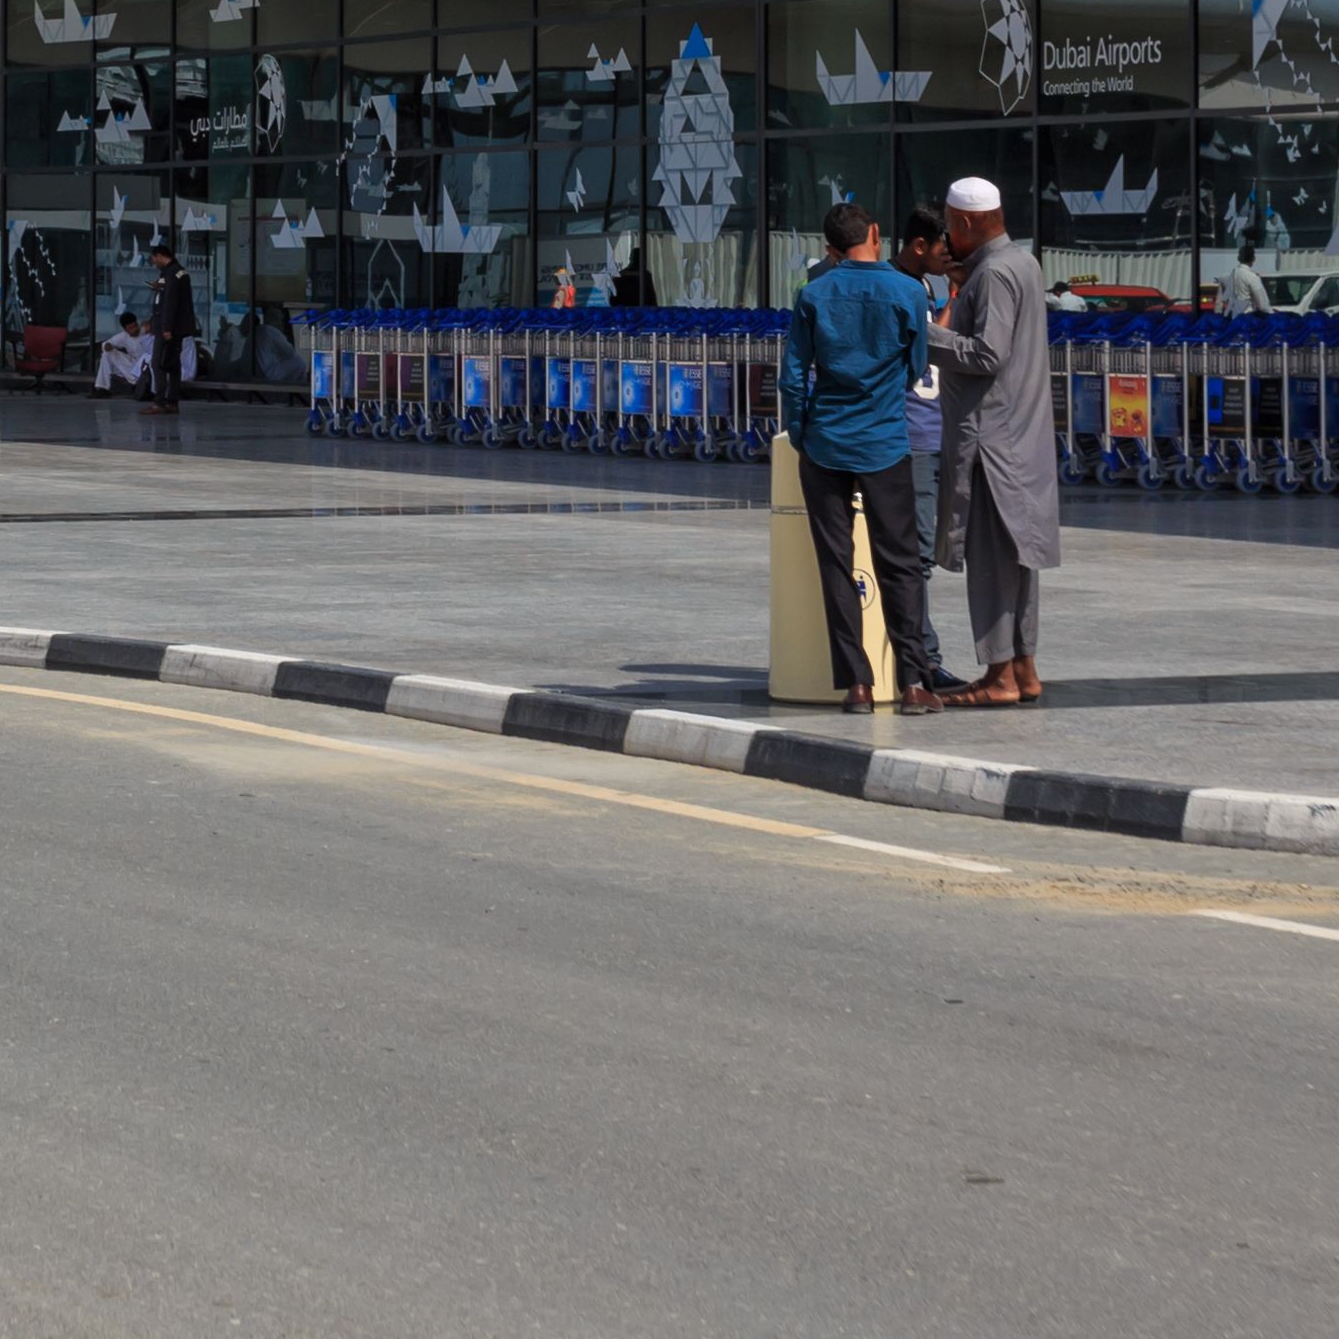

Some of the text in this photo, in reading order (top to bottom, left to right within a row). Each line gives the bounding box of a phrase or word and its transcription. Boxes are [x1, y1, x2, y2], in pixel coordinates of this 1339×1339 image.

[1042, 34, 1162, 72] Dubai Airports
[1042, 74, 1134, 97] Connecting the World
